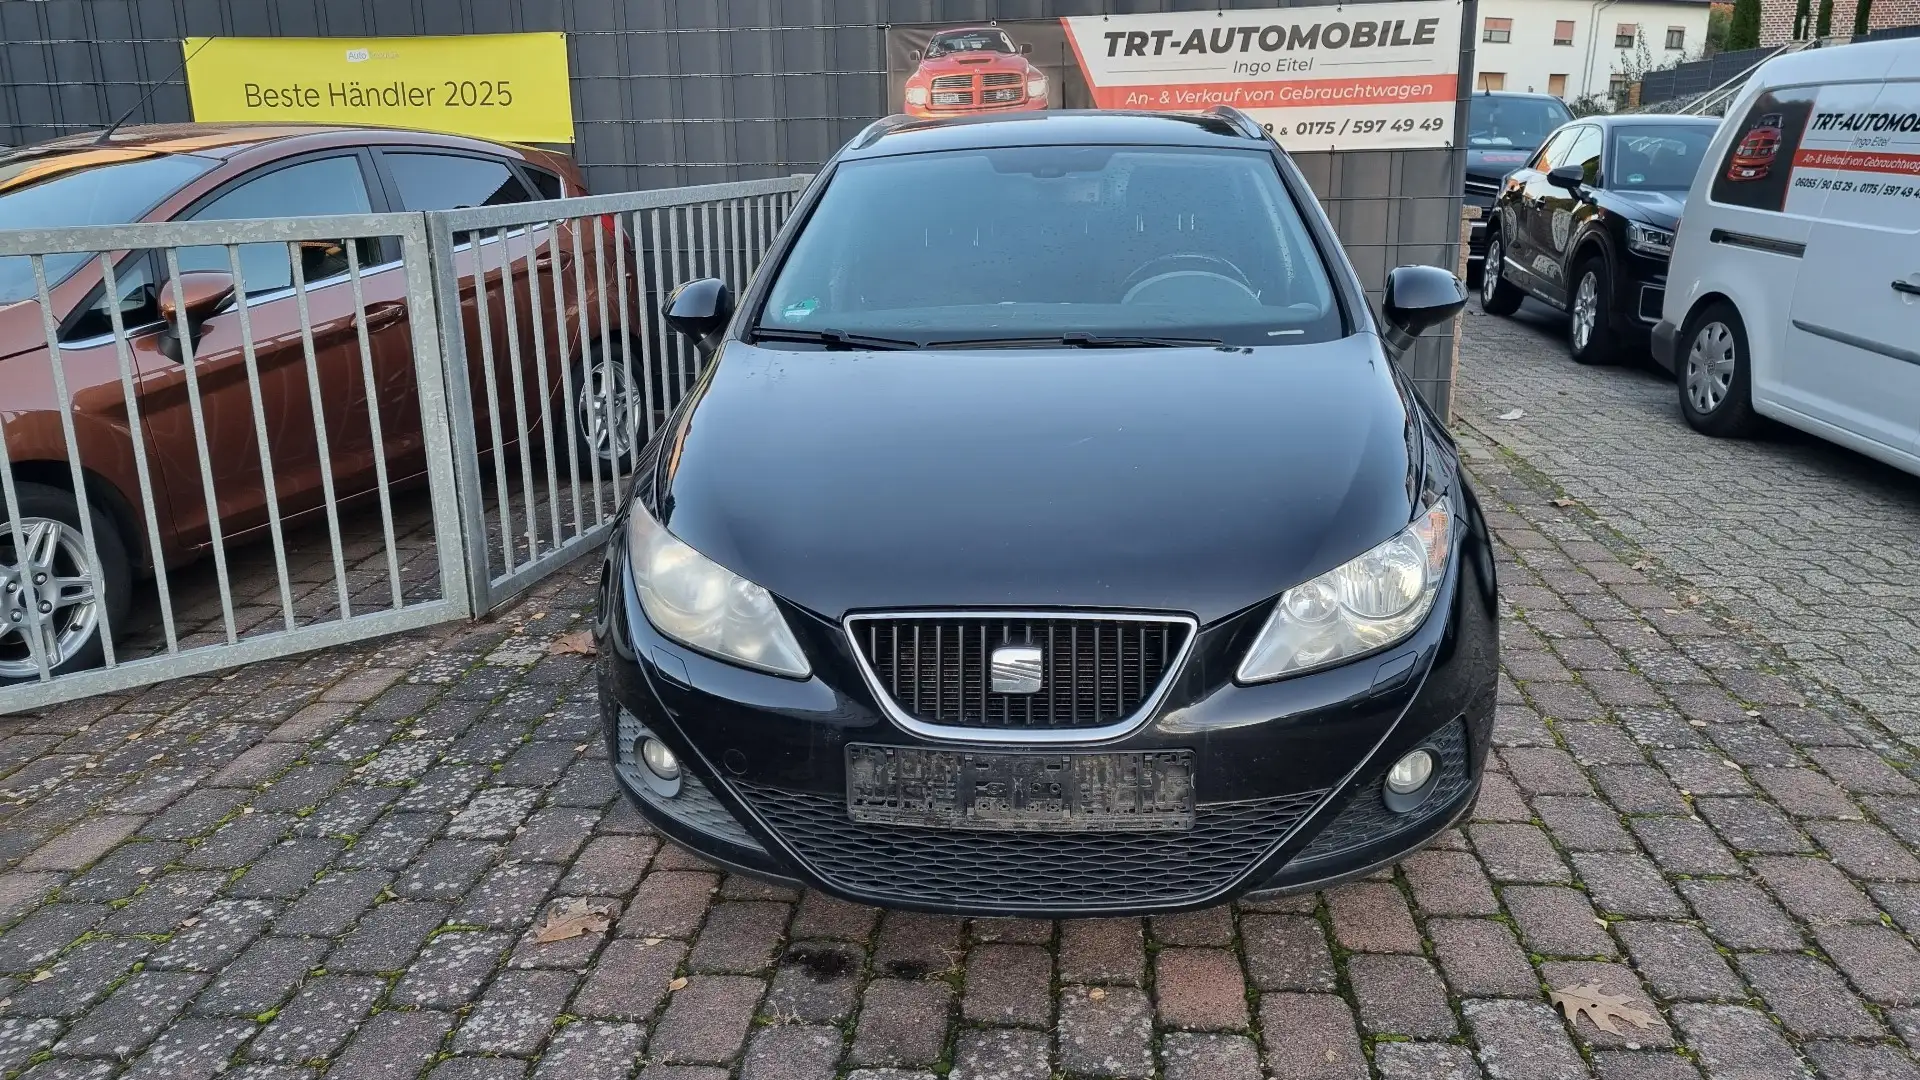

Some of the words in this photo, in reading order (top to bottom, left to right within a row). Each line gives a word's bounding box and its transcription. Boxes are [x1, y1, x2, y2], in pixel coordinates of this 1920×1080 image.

[1104, 18, 1440, 57] TRT-AUTOMOBILE
[1233, 60, 1271, 76] Ingo
[1276, 57, 1314, 72] Eitel
[244, 83, 320, 108] Beste
[328, 81, 436, 107] Händler
[444, 81, 513, 107] 2025
[1125, 92, 1155, 105] An-
[1159, 90, 1170, 104] &
[1175, 87, 1243, 104] Verkauf
[1244, 89, 1275, 102] von
[1279, 83, 1433, 101] Gebrauchtwagen
[1279, 126, 1288, 136] &
[1295, 121, 1336, 135] 0175
[1338, 118, 1351, 136] /
[1352, 119, 1387, 134] 597
[1390, 118, 1415, 132] 49
[1419, 117, 1444, 132] 49
[1822, 154, 1850, 166] Verkauf
[1850, 156, 1863, 166] von
[1795, 177, 1818, 188] 06055
[1821, 179, 1832, 189] 90
[1841, 181, 1853, 192] 29
[1860, 183, 1879, 194] 0175
[1883, 185, 1901, 196] 597
[1901, 186, 1914, 198] 49
[1914, 187, 1920, 199] 4
